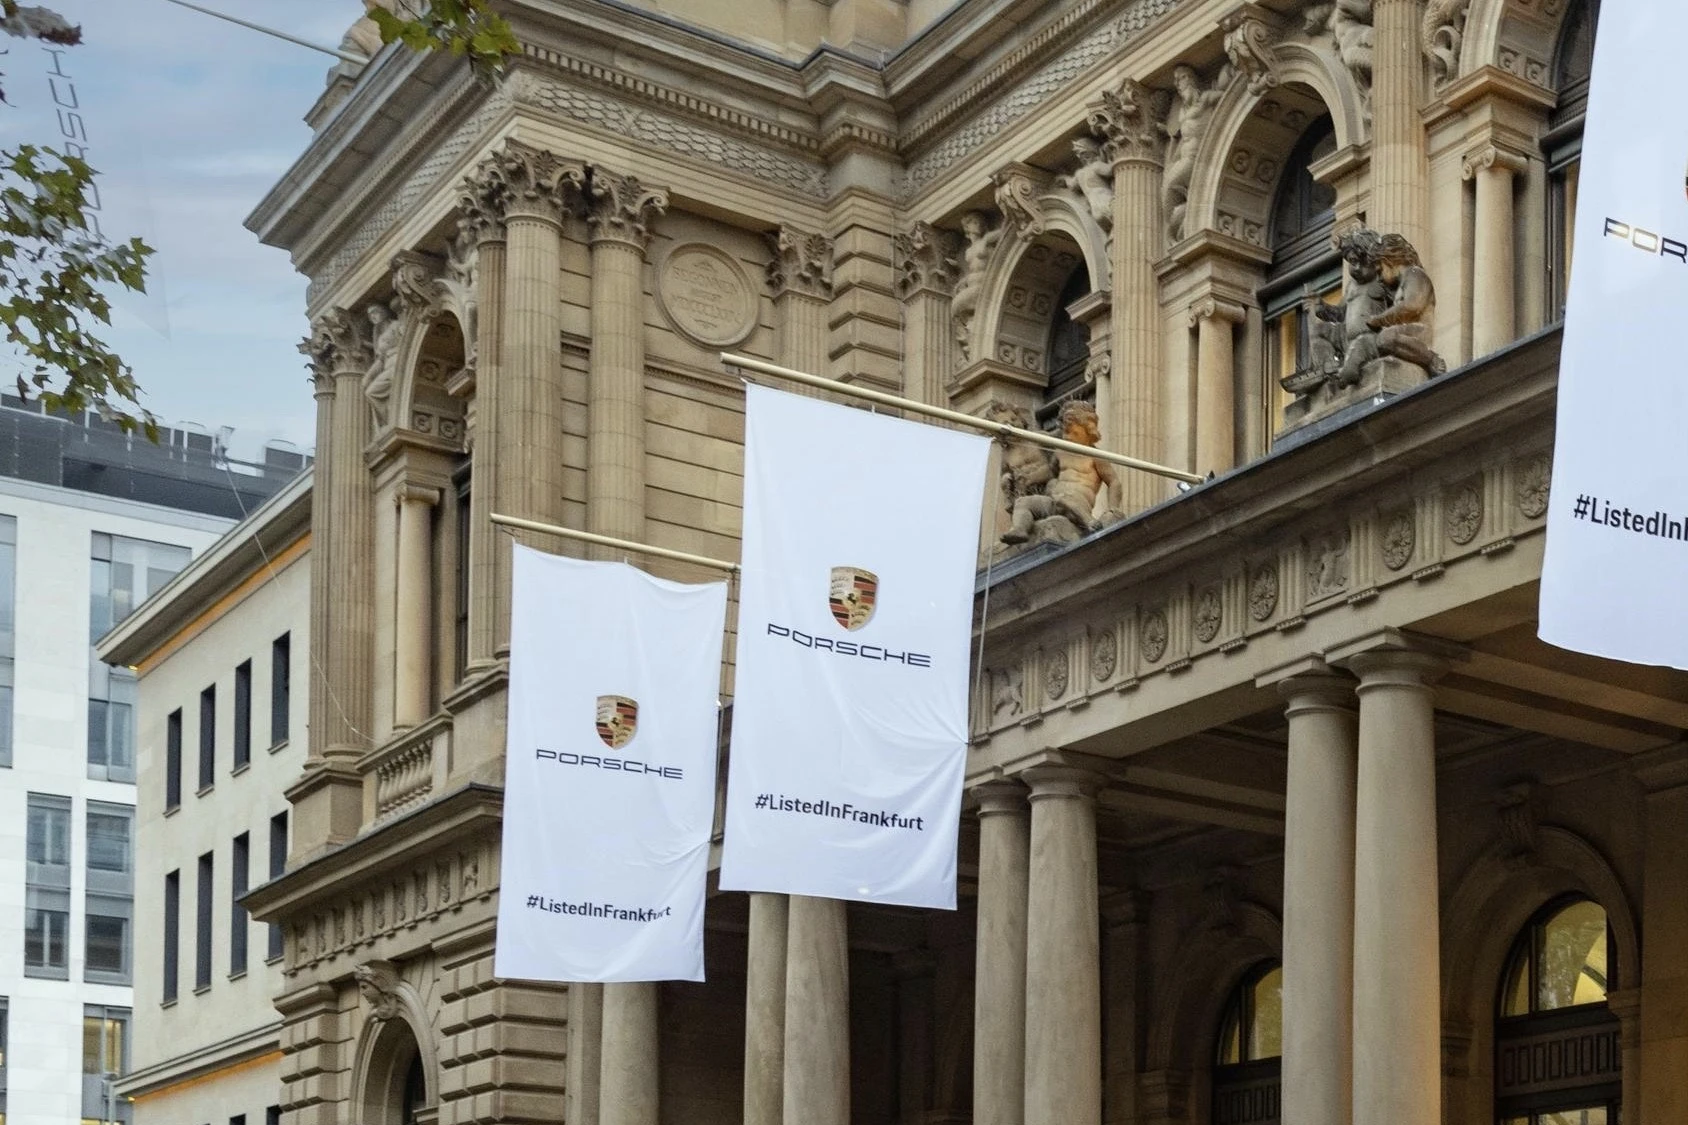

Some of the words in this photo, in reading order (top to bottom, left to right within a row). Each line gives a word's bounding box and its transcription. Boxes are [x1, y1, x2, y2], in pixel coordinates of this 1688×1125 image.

[767, 623, 931, 668] PORSCHE
[536, 749, 683, 780] PORSCHE
[755, 793, 923, 831] #ListedInFrankfurt
[526, 895, 671, 922] #ListedInFrankfurt
